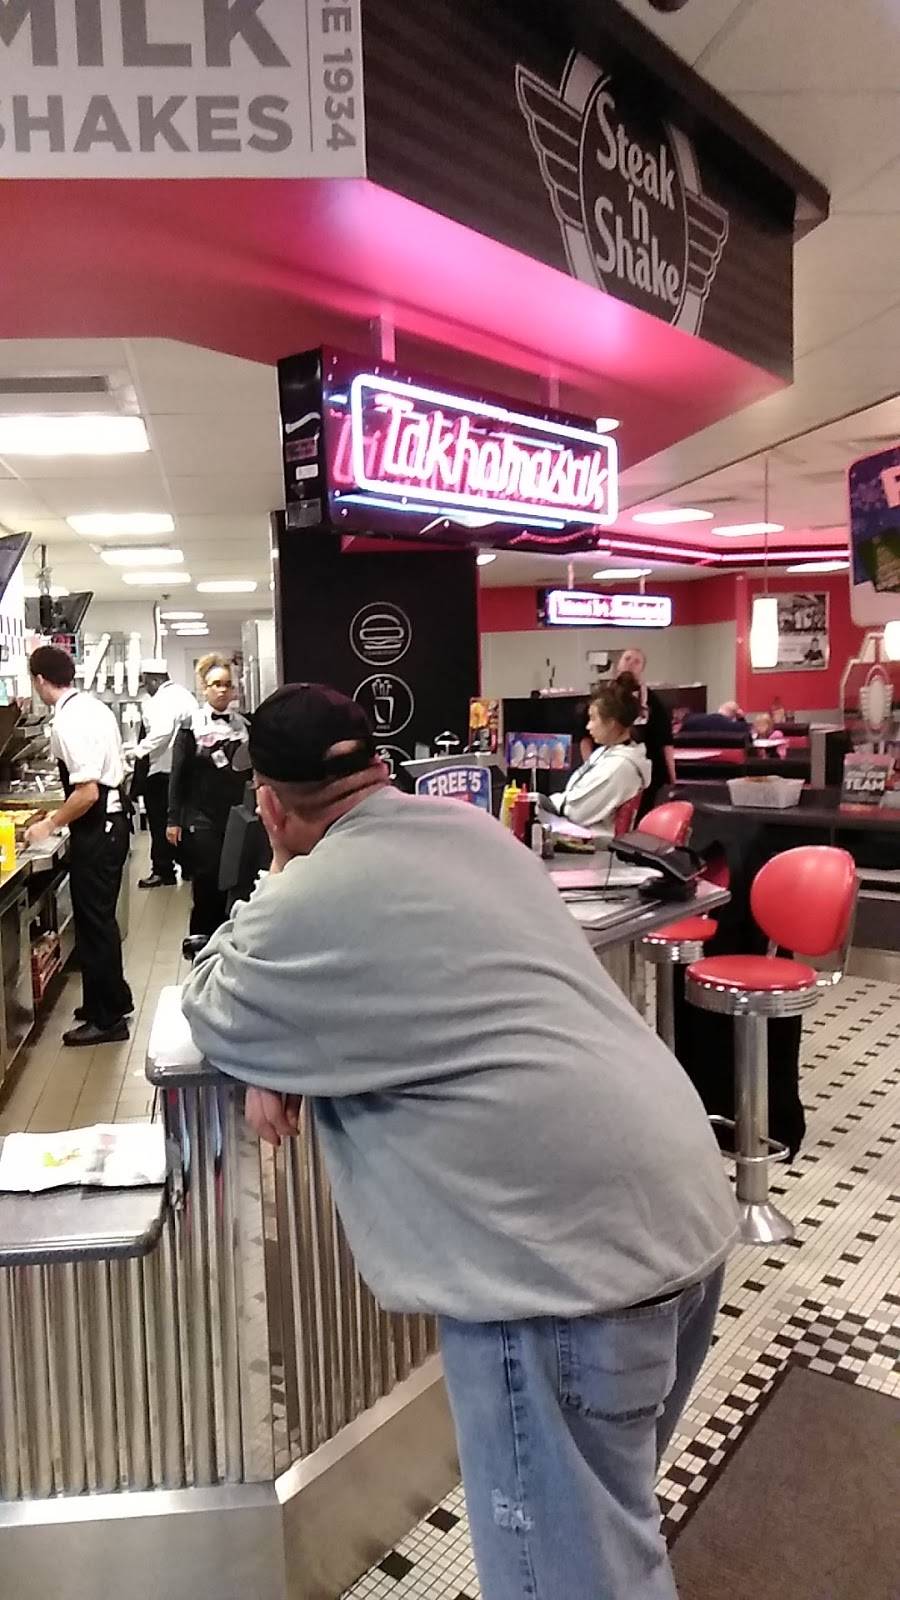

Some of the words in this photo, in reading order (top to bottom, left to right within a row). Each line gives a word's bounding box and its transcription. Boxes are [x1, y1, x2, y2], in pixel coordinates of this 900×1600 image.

[0, 94, 293, 153] HAKES
[323, 48, 357, 151] 1934
[597, 91, 675, 210] Steak
[594, 196, 680, 305] Shake
[427, 771, 468, 796] FREE
[844, 778, 885, 791] TEAM
